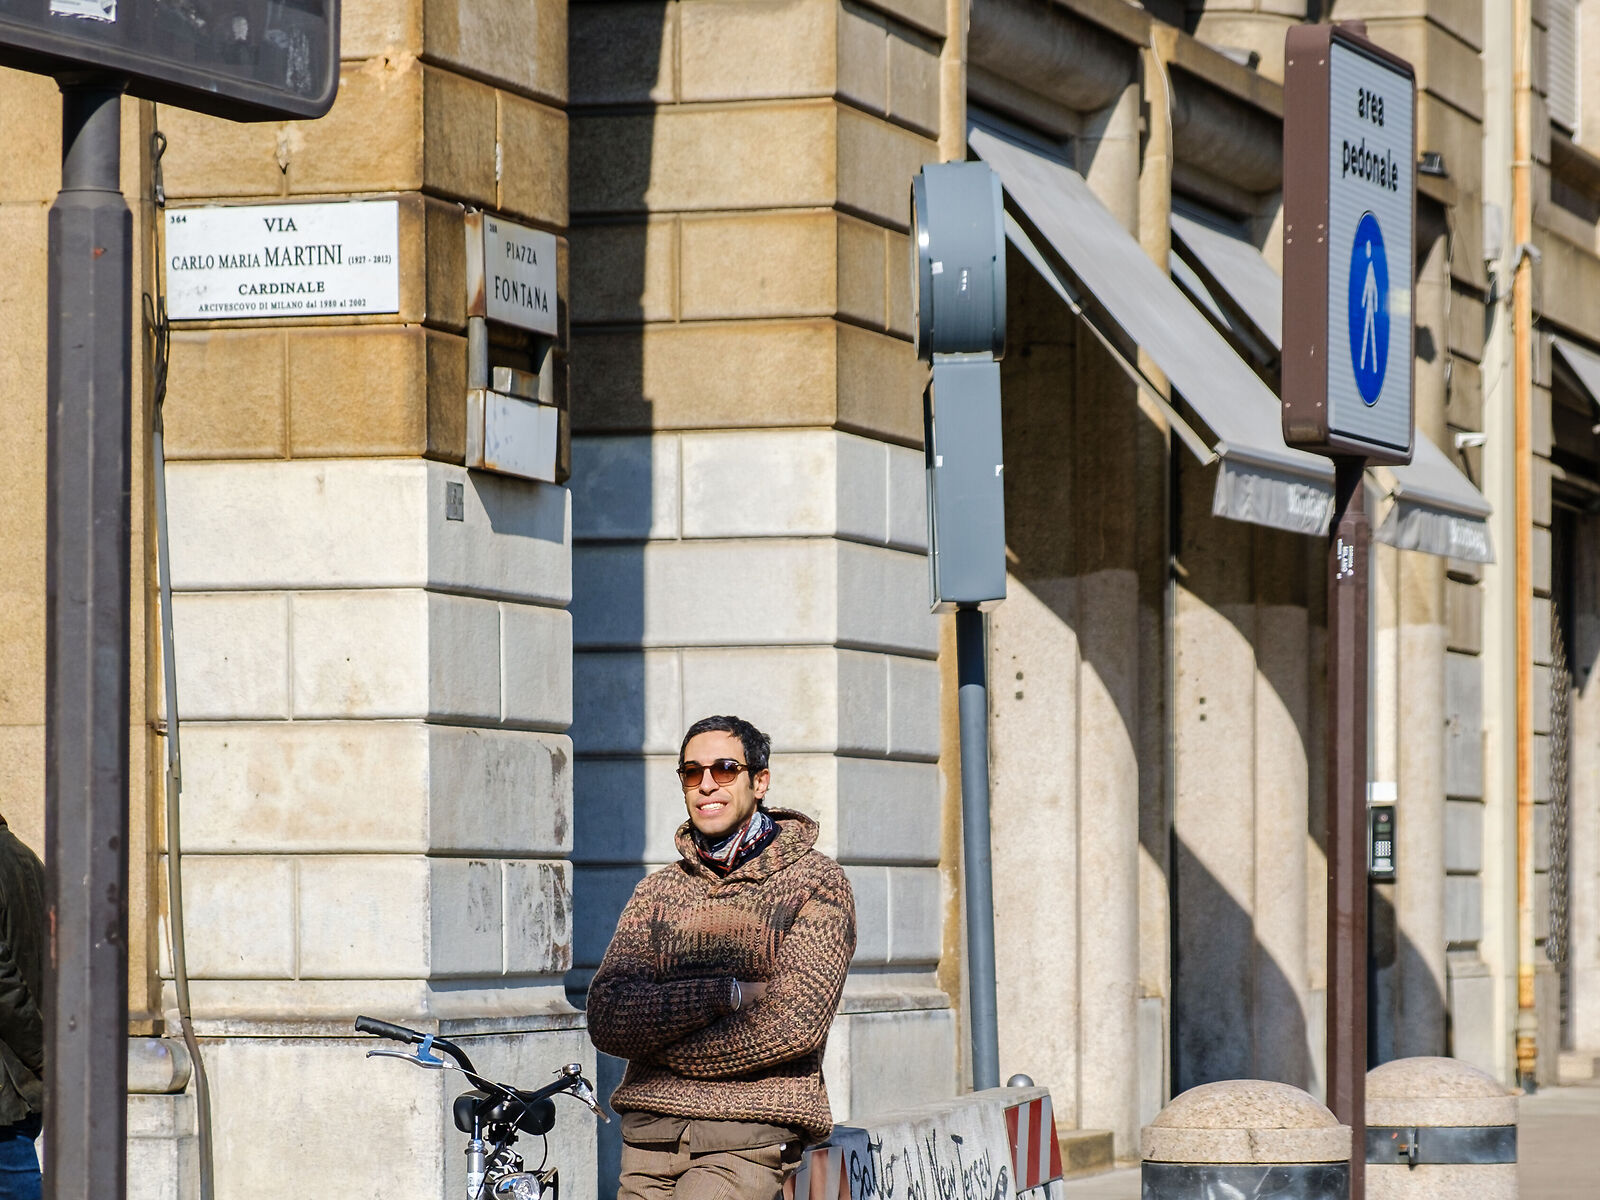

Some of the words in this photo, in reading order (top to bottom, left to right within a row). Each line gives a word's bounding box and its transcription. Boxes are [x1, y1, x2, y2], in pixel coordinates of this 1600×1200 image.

[1358, 87, 1385, 127] area
[1342, 137, 1399, 192] pedonale
[170, 215, 187, 225] 364
[264, 217, 298, 233] VIA
[171, 255, 215, 271] CARLO
[218, 253, 261, 269] MARIA
[264, 244, 343, 267] MARTINI
[506, 241, 538, 265] PIAZZA
[238, 281, 326, 296] CARDINALE
[494, 275, 548, 313] FONTANA
[198, 302, 257, 312] ARCIVESCOVO
[259, 301, 269, 310] DI
[270, 300, 304, 310] MILANO
[305, 300, 317, 308] dal
[320, 299, 337, 308] 1980
[340, 299, 347, 307] al
[349, 298, 367, 307] 2002
